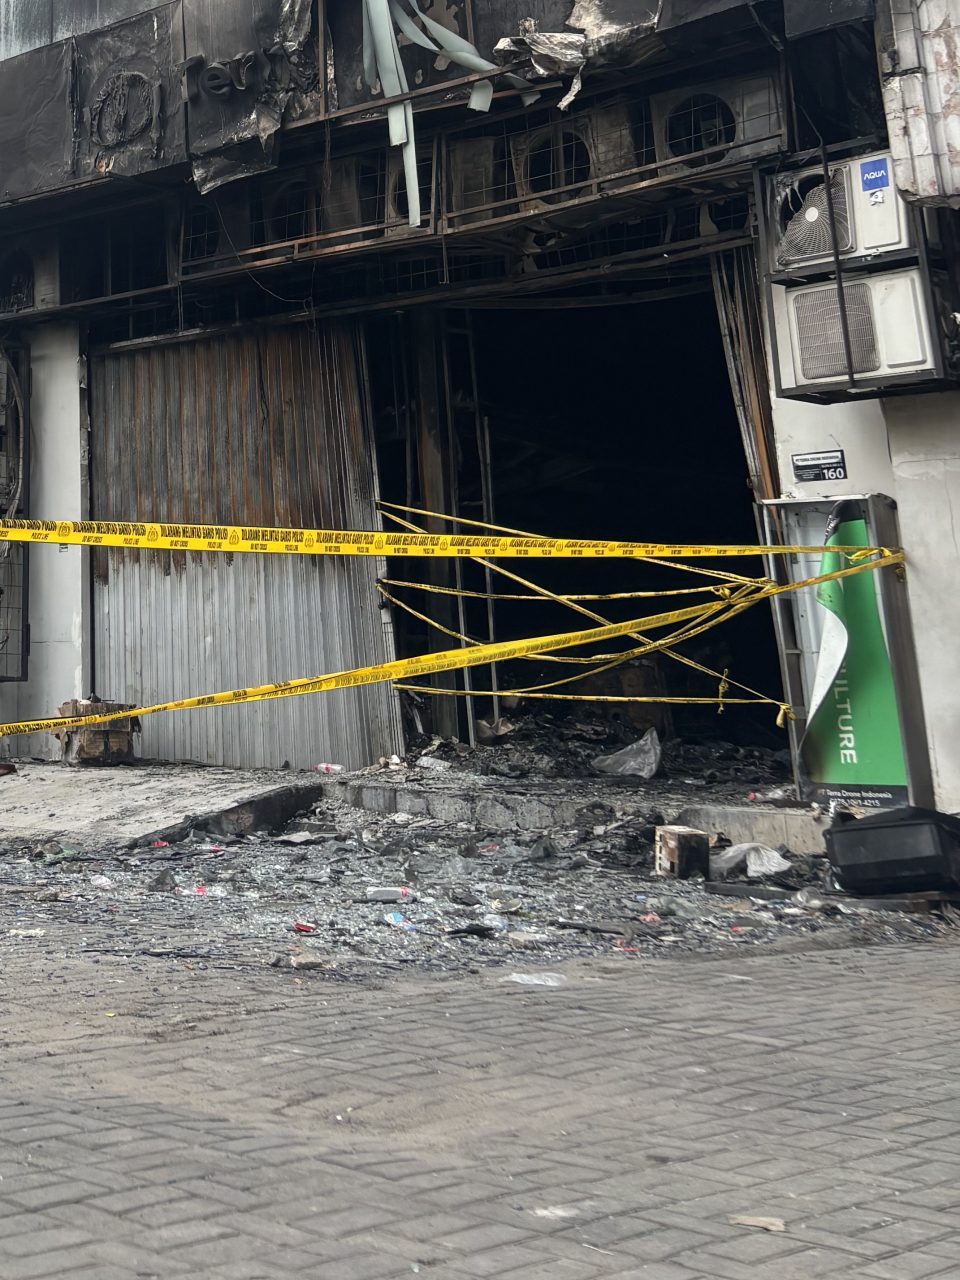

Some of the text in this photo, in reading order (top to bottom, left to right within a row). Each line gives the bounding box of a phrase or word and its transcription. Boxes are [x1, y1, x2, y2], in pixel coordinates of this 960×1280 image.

[864, 170, 886, 180] AQUA
[823, 468, 844, 479] 160
[160, 525, 229, 540] DILARANG MELINTAS GARIS POLISI
[841, 790, 861, 798] Drone
[861, 791, 893, 799] Indonesia
